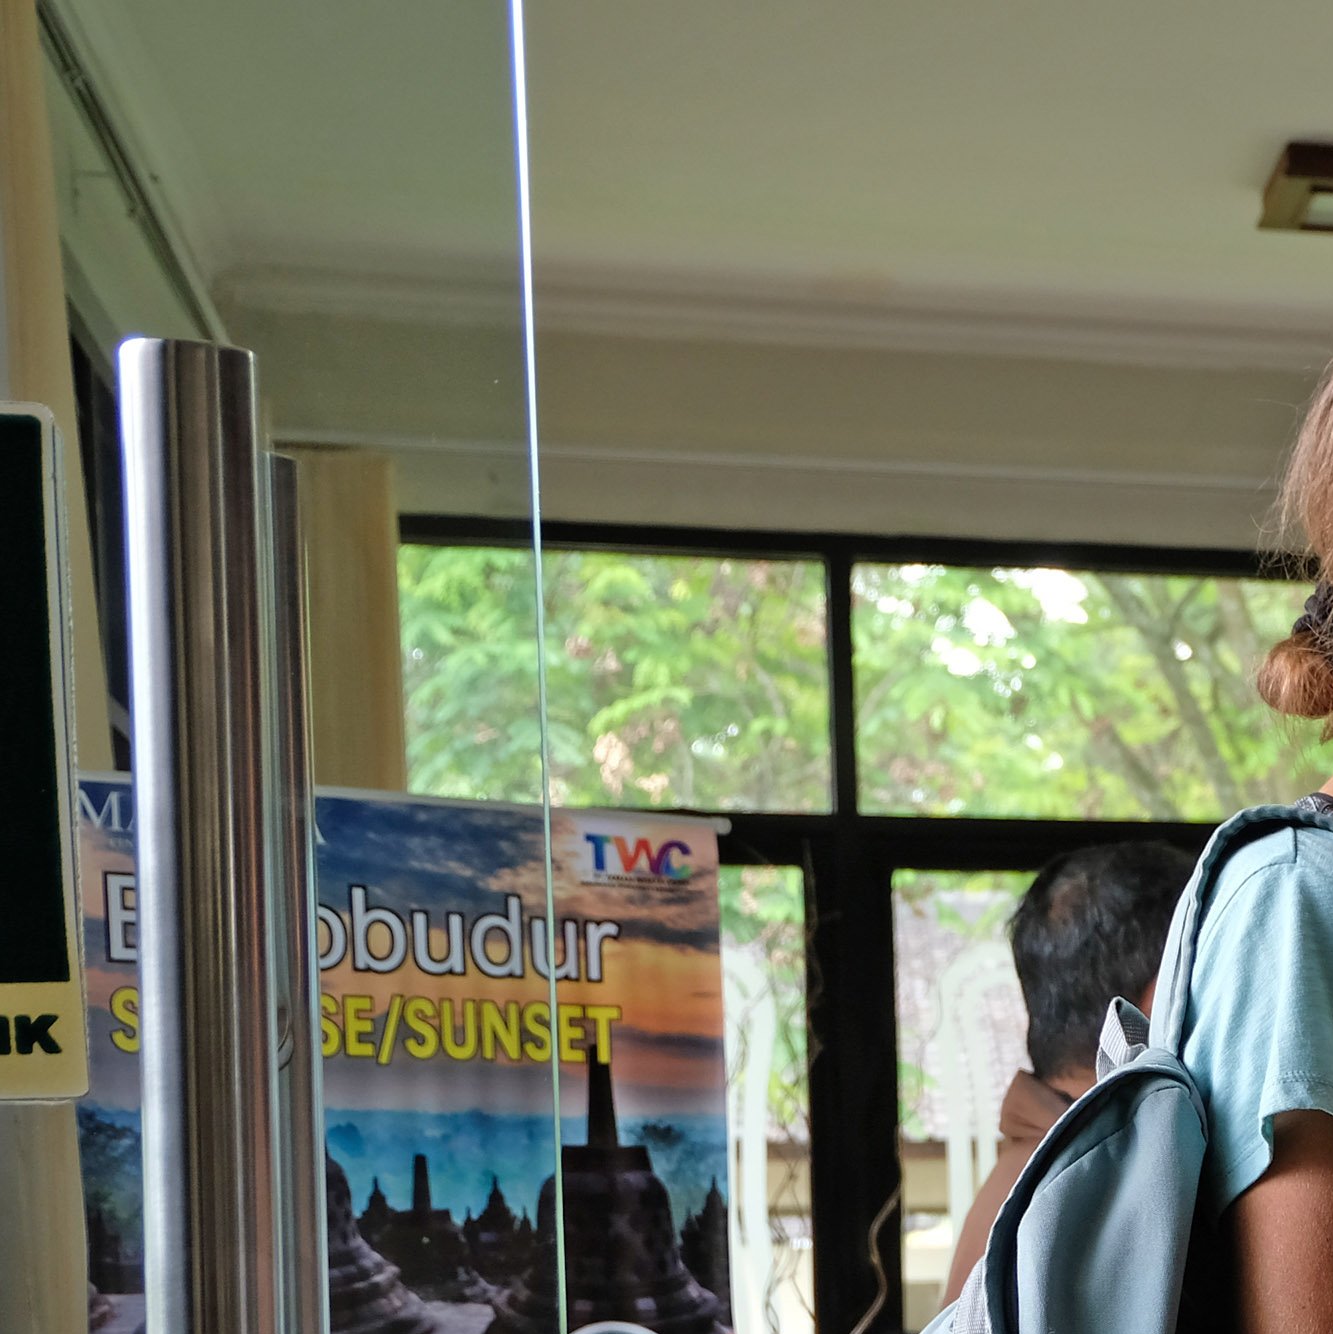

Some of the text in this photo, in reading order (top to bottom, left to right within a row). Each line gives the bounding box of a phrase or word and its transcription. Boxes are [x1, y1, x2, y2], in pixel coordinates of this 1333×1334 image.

[584, 833, 692, 879] TWC
[103, 871, 620, 983] Bobudur
[110, 986, 622, 1065] SSE/SUNSET
